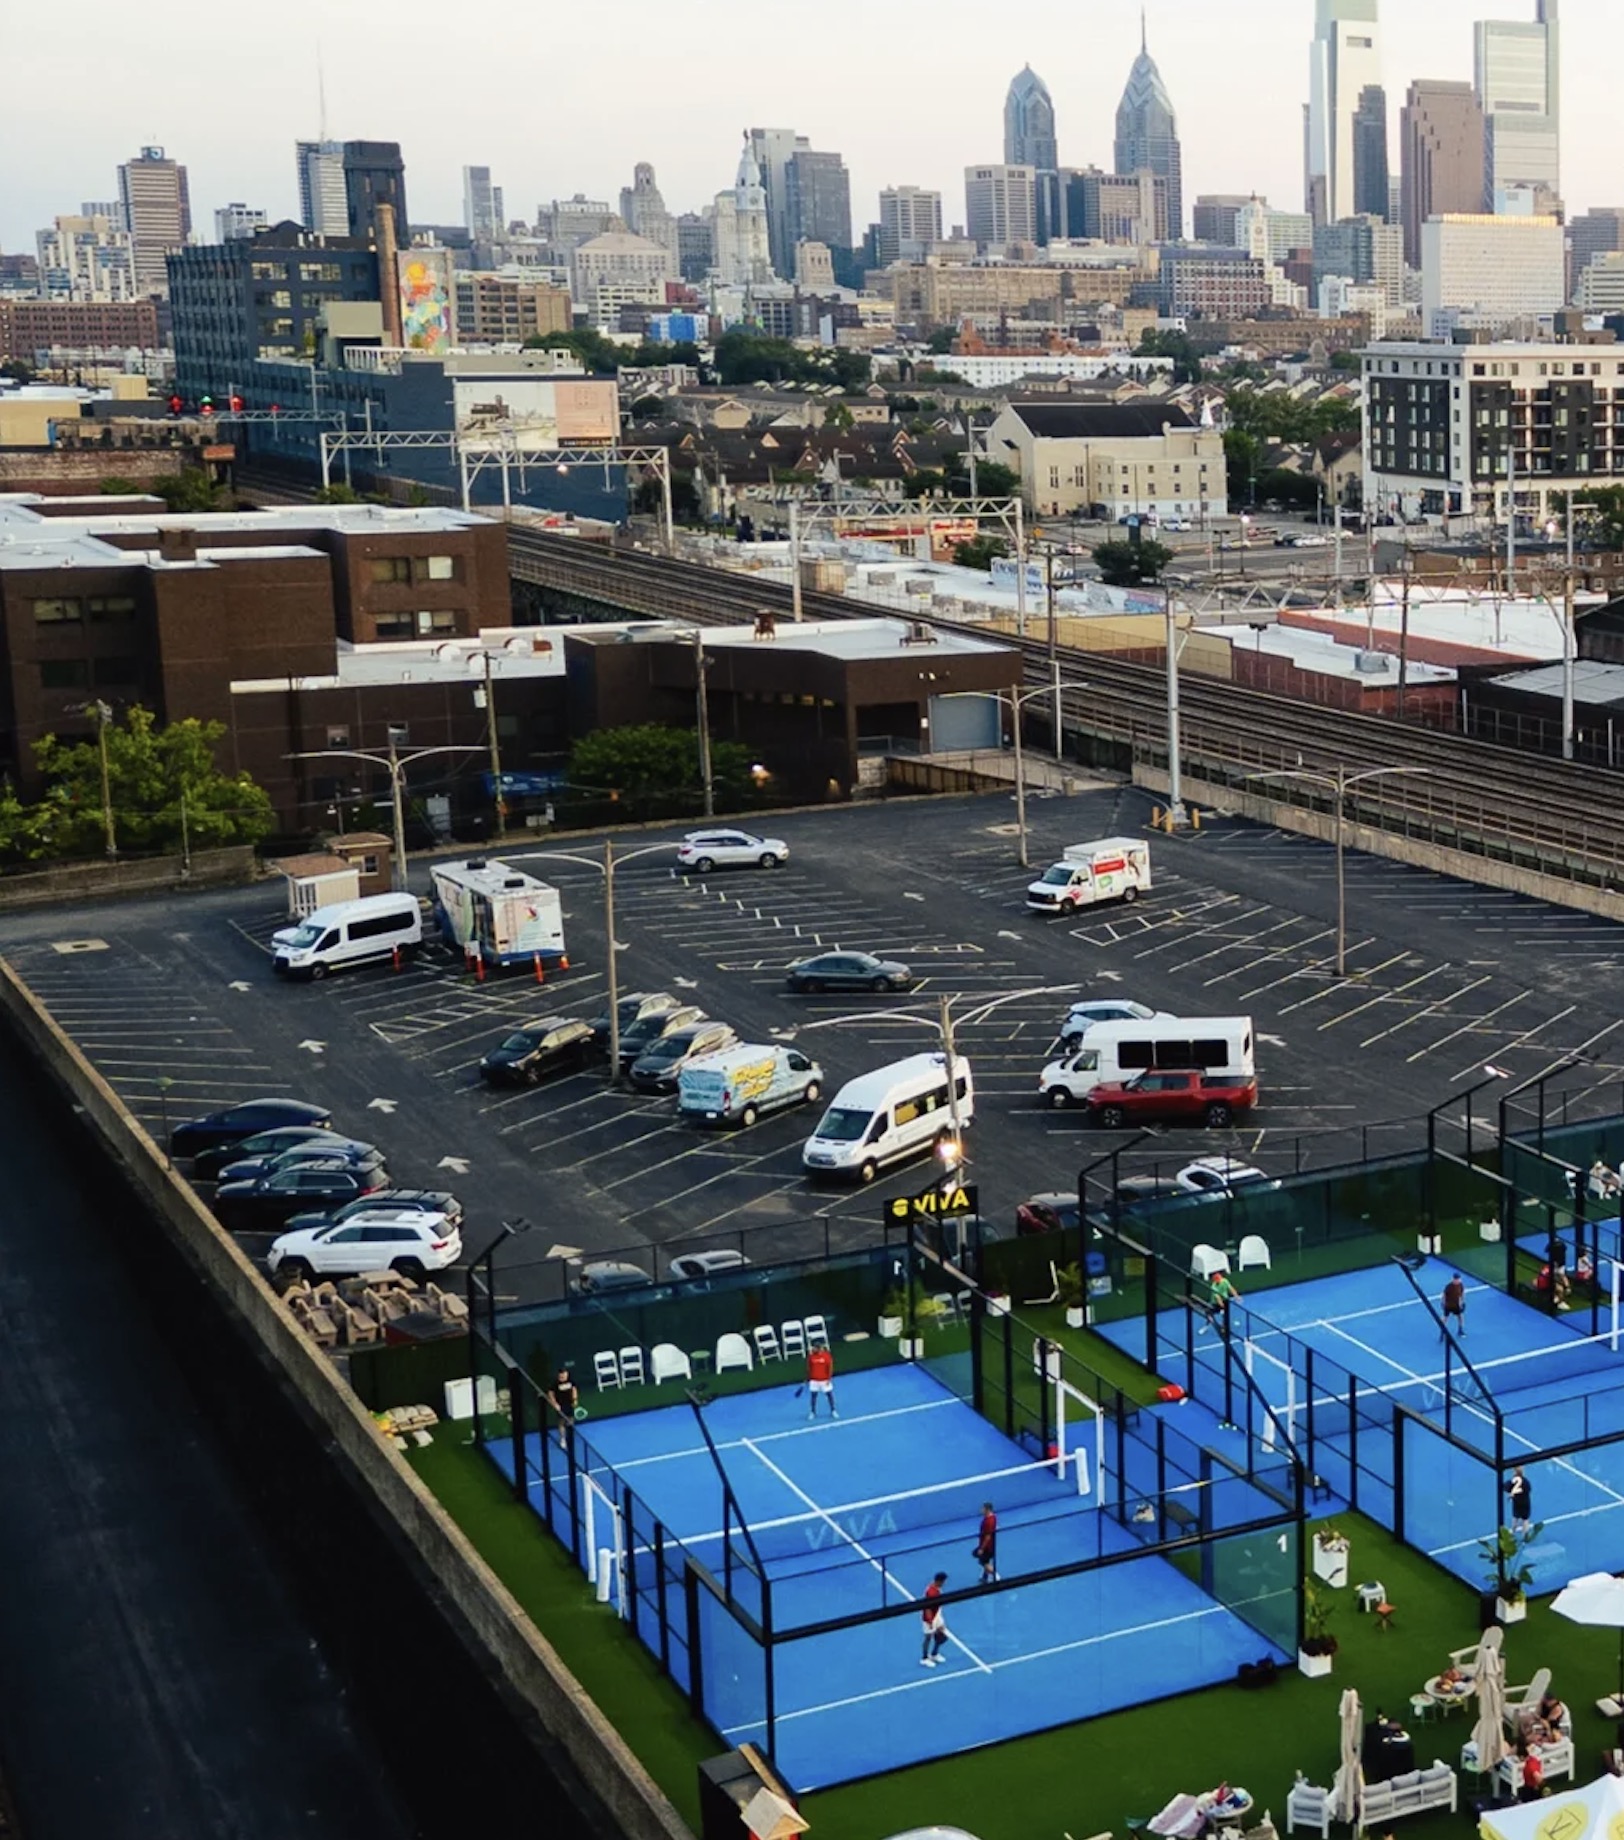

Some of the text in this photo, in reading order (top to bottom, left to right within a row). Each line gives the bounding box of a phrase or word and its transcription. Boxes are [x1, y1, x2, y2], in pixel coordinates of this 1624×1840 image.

[914, 1188, 970, 1213] VIVA
[1511, 1476, 1523, 1494] 2
[1276, 1533, 1288, 1553] 1
